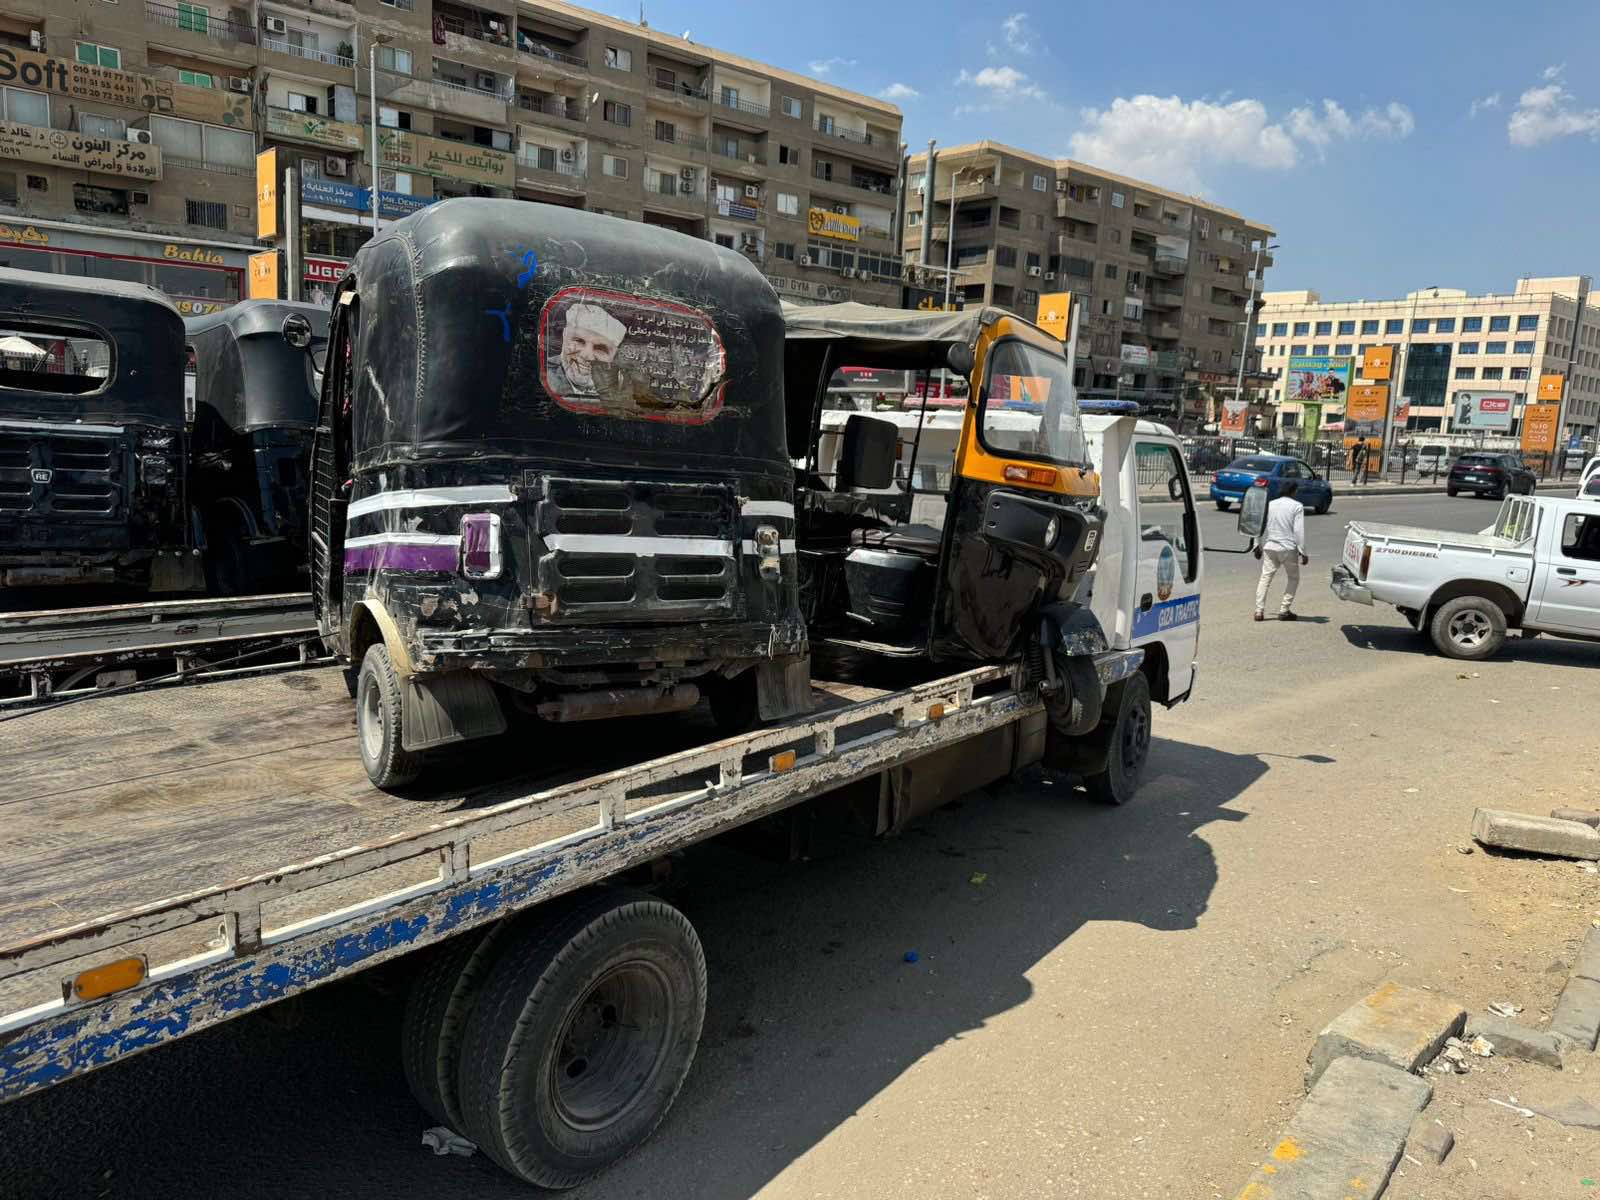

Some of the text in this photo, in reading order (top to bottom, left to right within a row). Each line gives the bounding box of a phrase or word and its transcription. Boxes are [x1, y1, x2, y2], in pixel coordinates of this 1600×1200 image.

[0, 48, 69, 92] Soft
[11, 127, 31, 138] خالد
[72, 137, 146, 160] مركز البنون
[52, 152, 80, 163] النساء
[428, 150, 504, 175] بوابتك للخير
[306, 183, 354, 197] مركز العناية
[163, 244, 224, 265] Bahia
[791, 279, 809, 291] GYM
